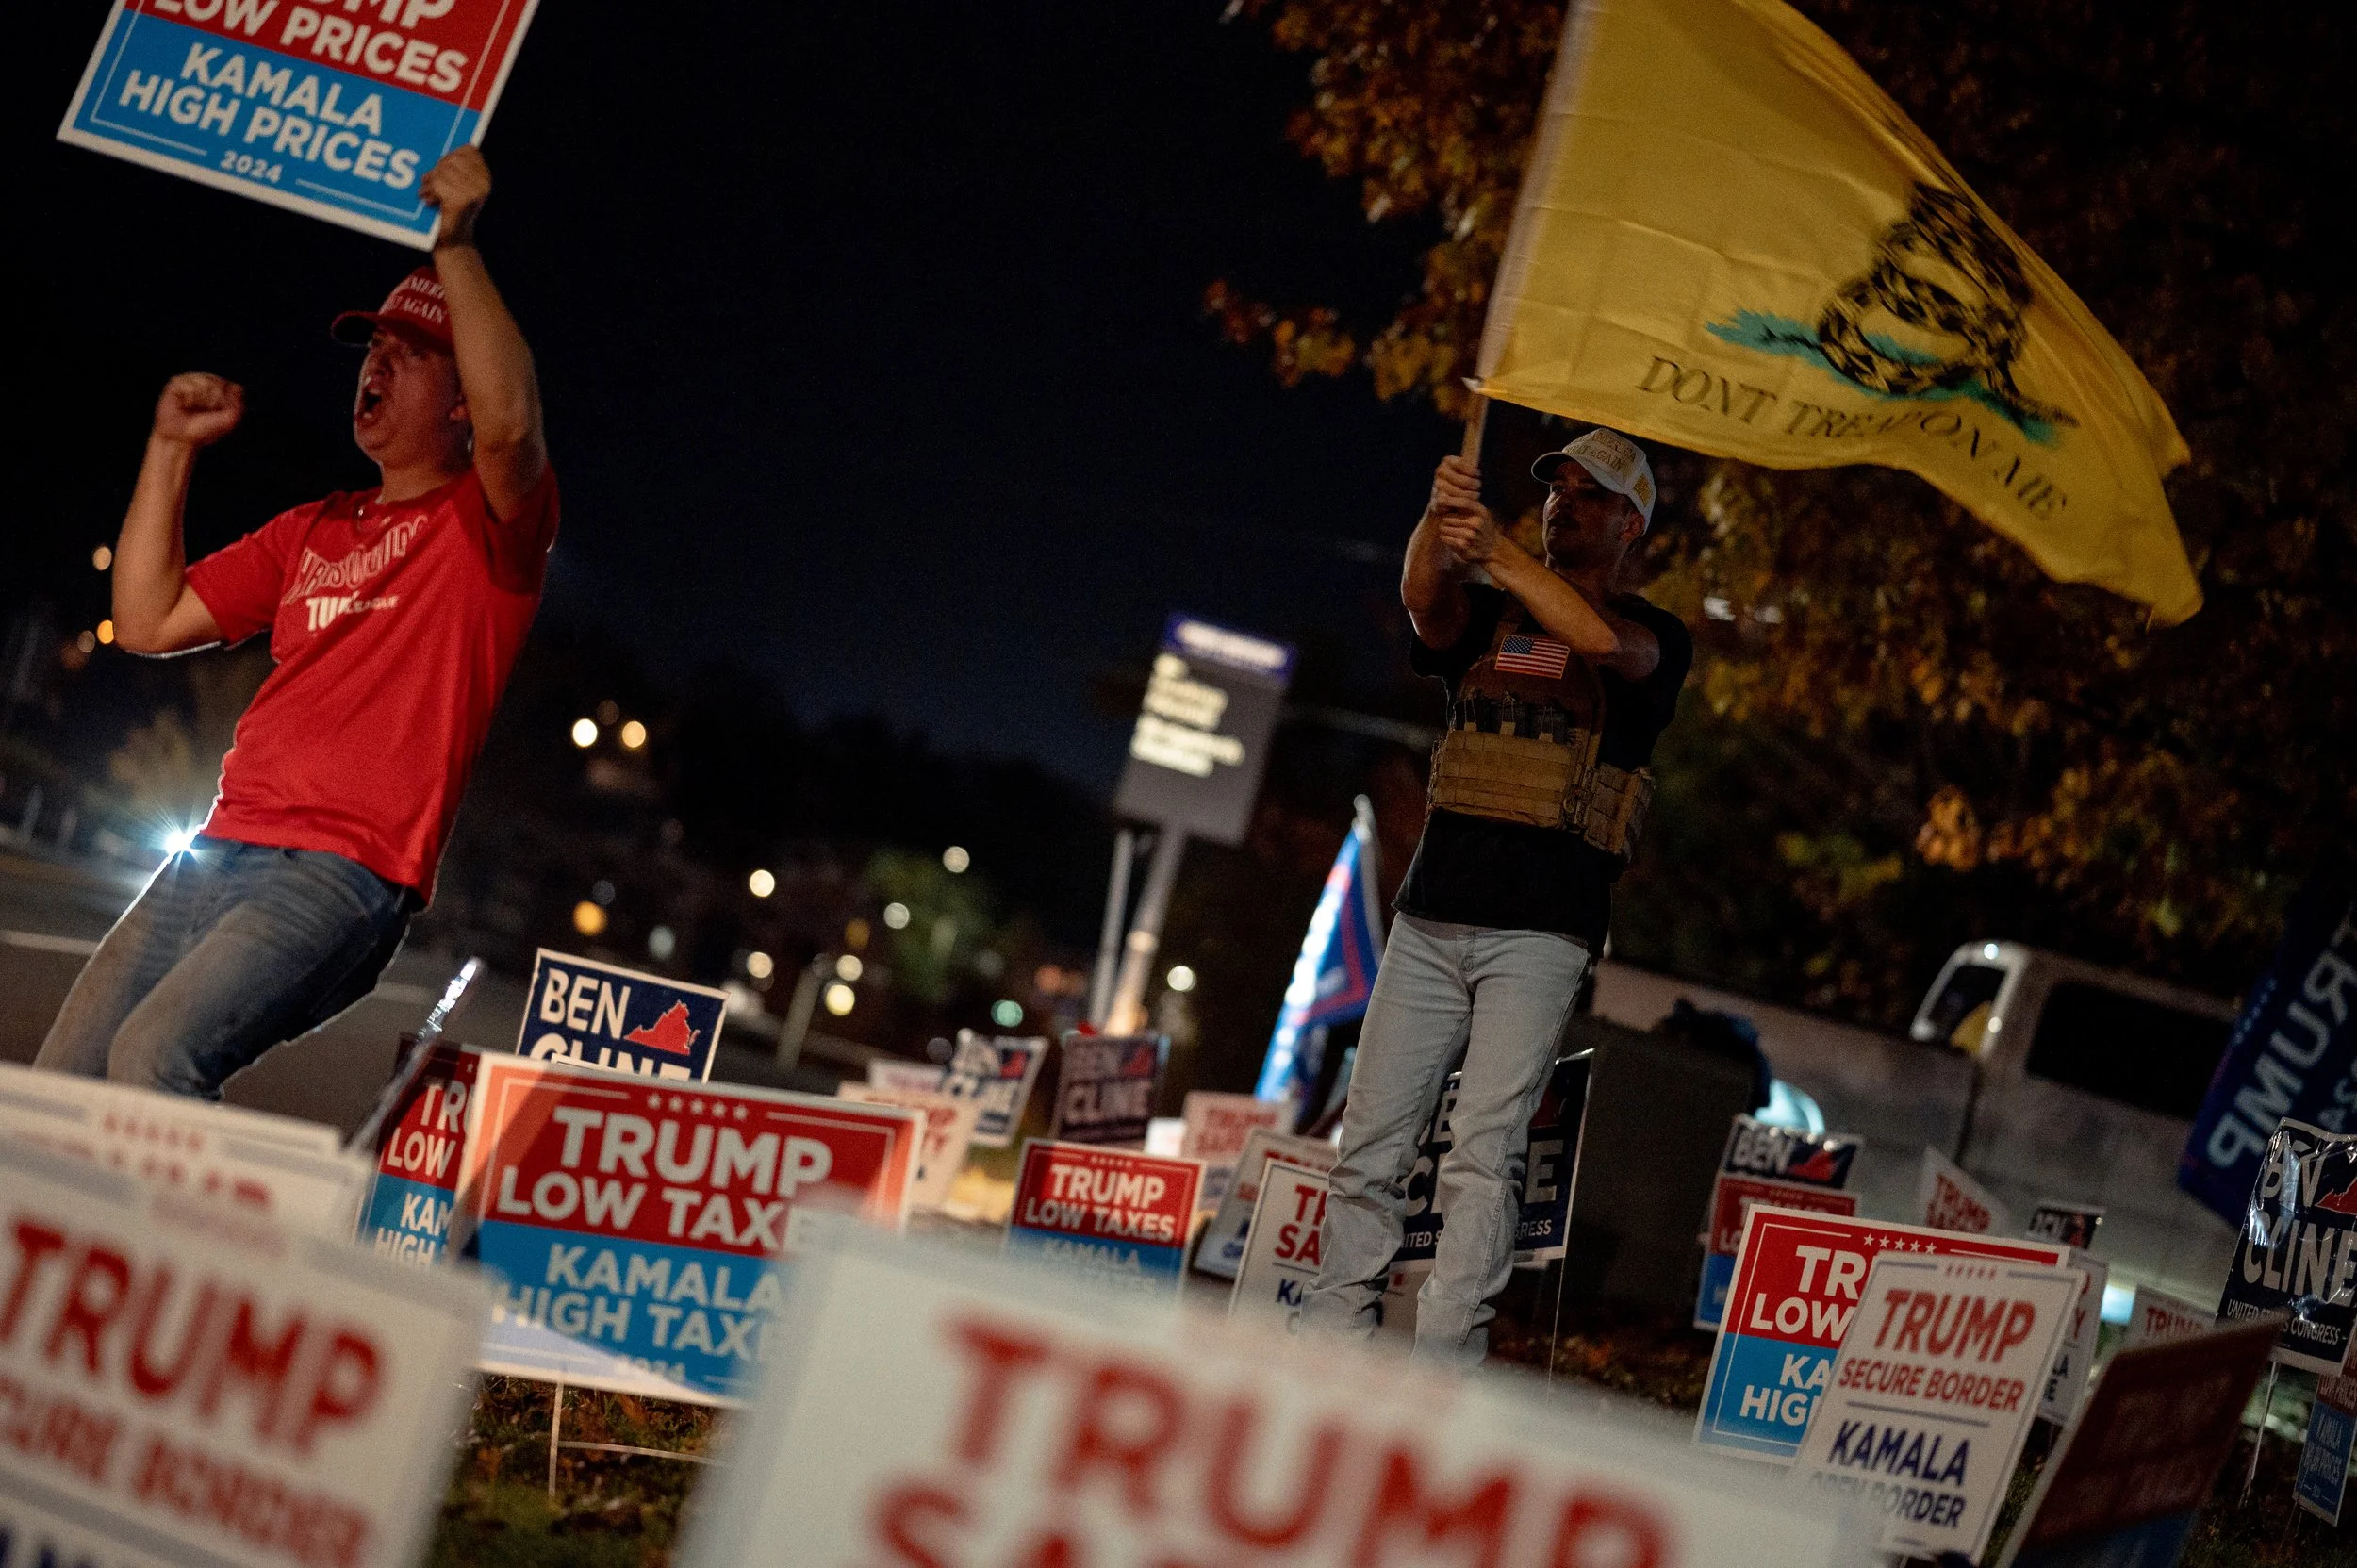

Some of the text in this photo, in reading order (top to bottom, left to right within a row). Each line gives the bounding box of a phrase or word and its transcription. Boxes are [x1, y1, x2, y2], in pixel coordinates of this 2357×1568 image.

[280, 6, 469, 92] PRICES
[181, 42, 383, 137] KAMALA
[119, 69, 420, 190] HIGH PRICES
[219, 150, 283, 183] 2024
[1636, 355, 1777, 424] DONT
[539, 967, 631, 1040] BEN
[387, 1127, 456, 1179] LOW
[552, 1105, 833, 1198] TRUMP
[497, 1165, 647, 1230] LOW
[1024, 1197, 1176, 1244] LOW TAXES
[1050, 1163, 1167, 1211] TRUMP
[546, 1242, 784, 1312] KAMALA
[1795, 1245, 1878, 1301] TR
[491, 1282, 632, 1344] HIGH
[1749, 1292, 1857, 1342] LOW
[1874, 1288, 2036, 1364] TRUMP
[1838, 1357, 1925, 1397] SECURE
[1923, 1368, 2027, 1412] BORDER
[1827, 1418, 1970, 1487] KAMALA
